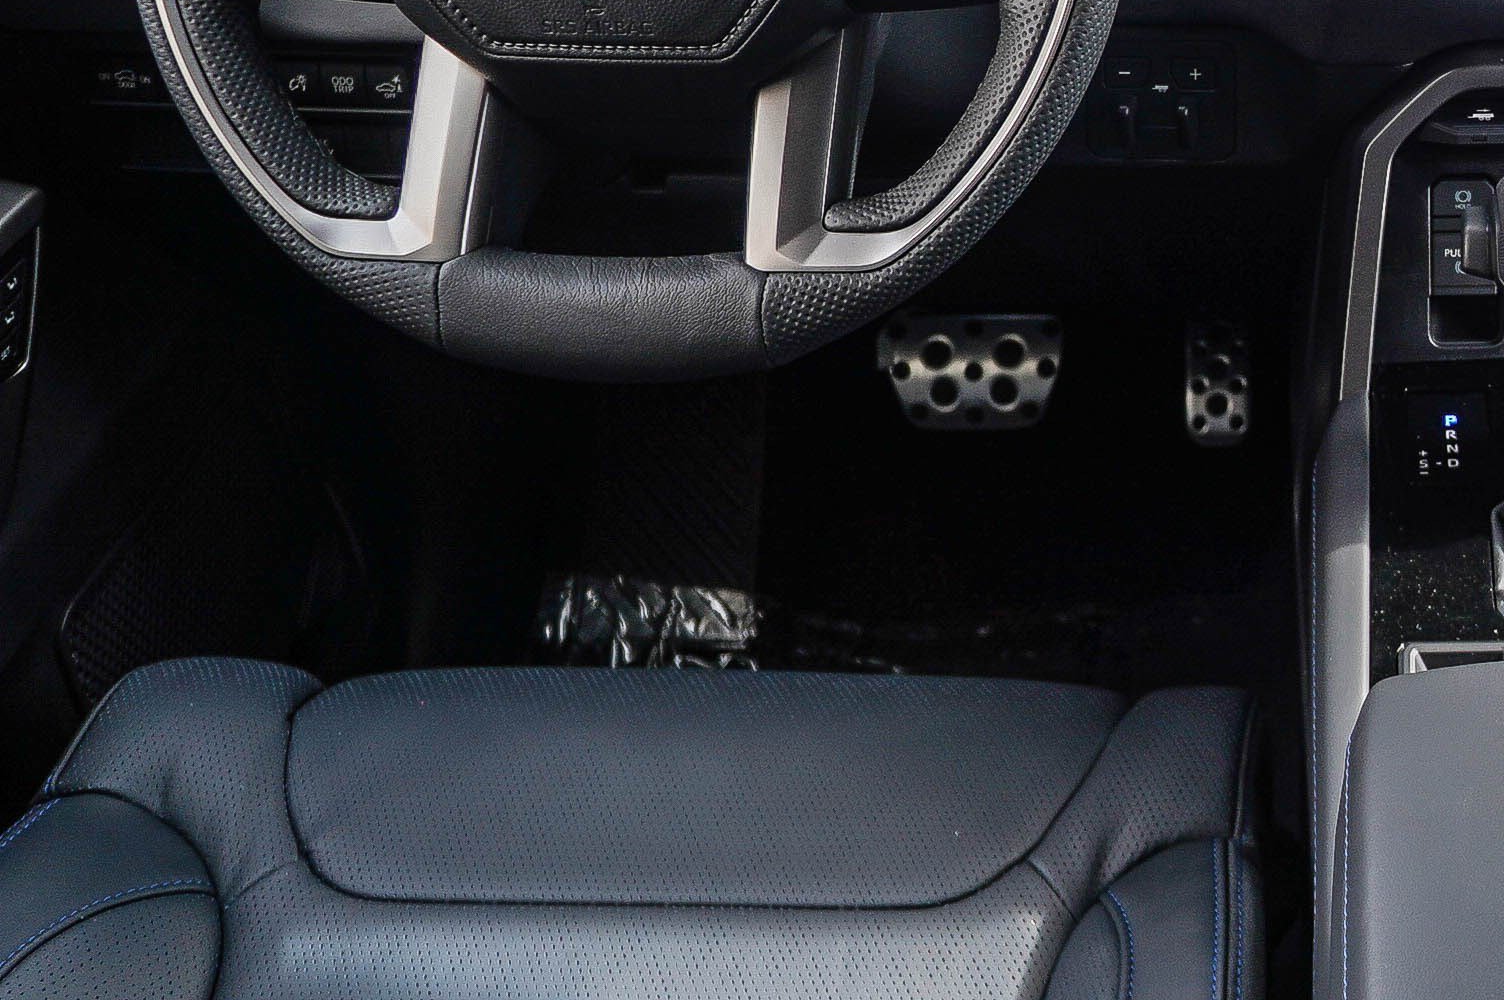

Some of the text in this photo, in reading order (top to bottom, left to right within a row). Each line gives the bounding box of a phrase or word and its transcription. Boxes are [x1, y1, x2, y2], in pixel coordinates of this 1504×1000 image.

[331, 76, 354, 86] ODO
[1445, 415, 1457, 427] P
[1446, 430, 1458, 439] R
[1447, 444, 1458, 453] N
[1420, 459, 1428, 469] S
[1447, 458, 1459, 468] D
